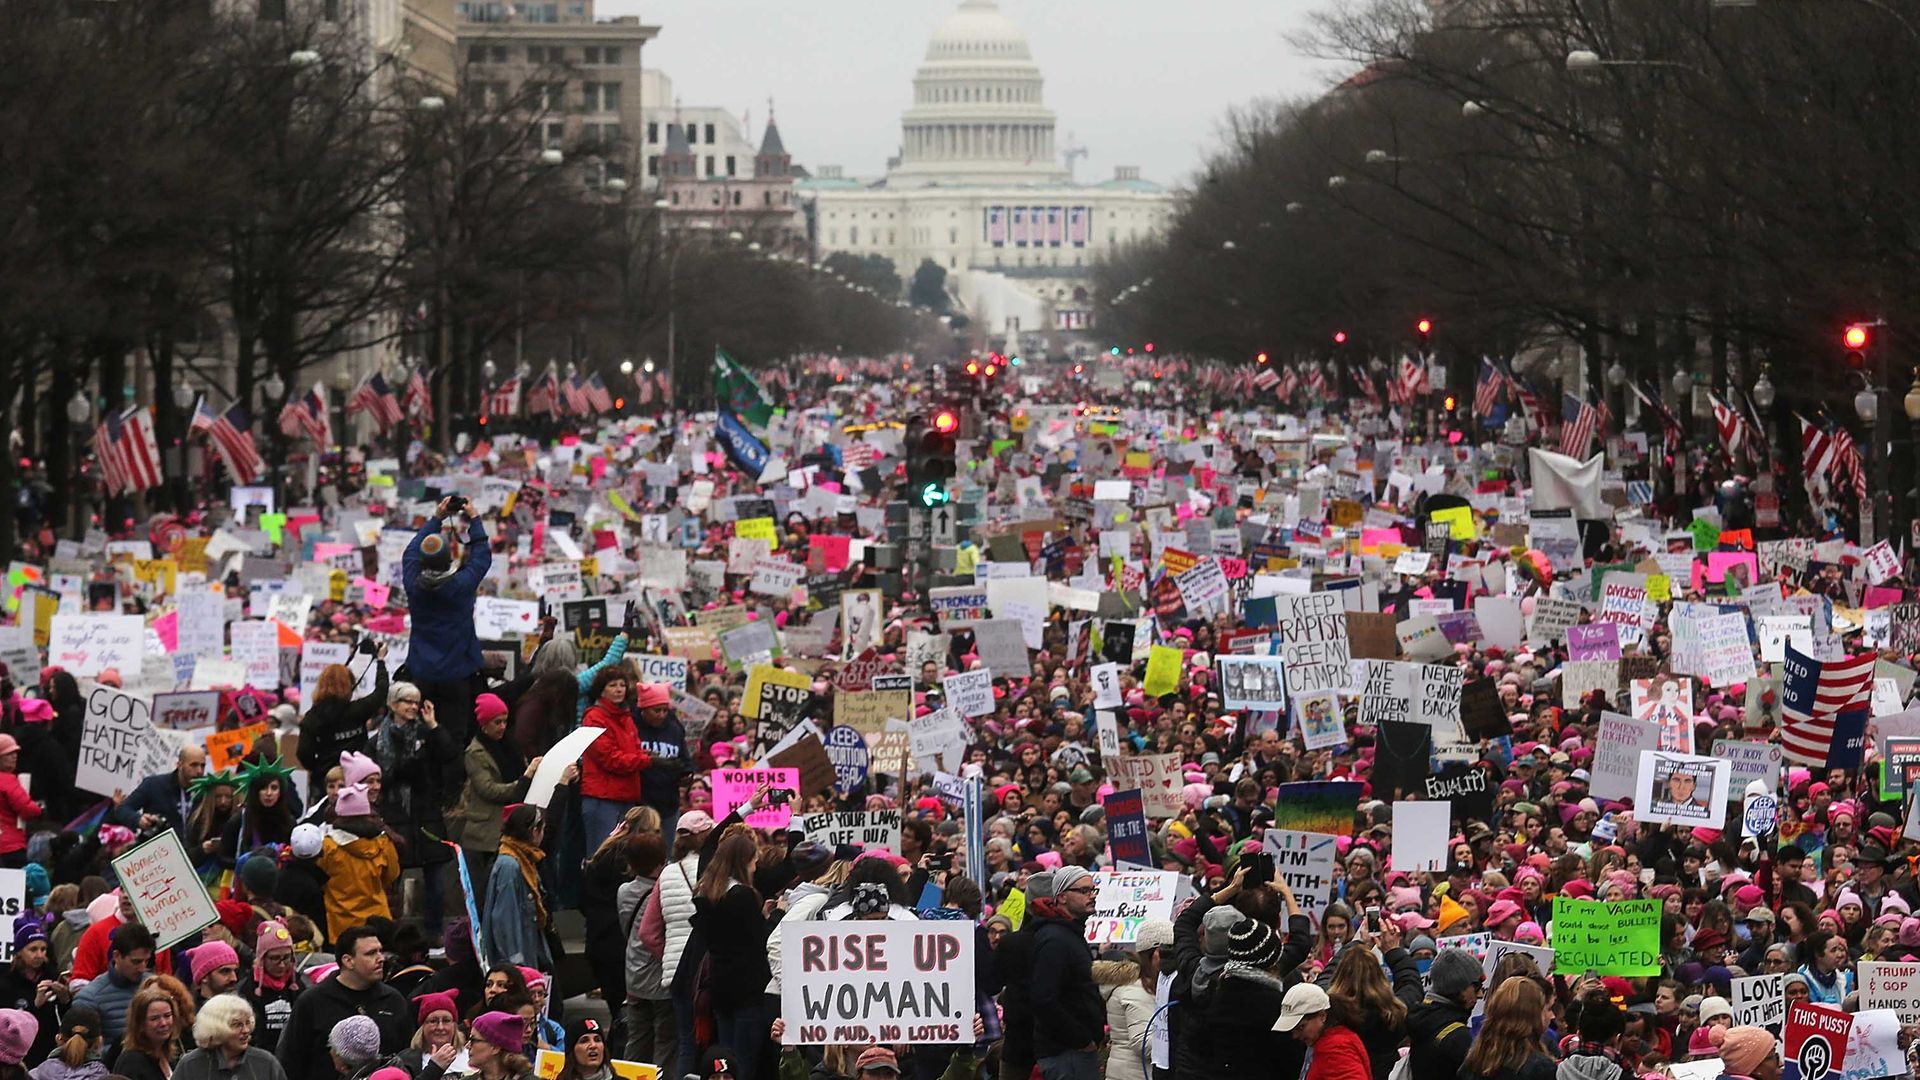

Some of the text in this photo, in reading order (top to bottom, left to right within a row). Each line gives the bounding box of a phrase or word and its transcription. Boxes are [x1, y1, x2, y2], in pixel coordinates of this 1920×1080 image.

[753, 570, 791, 587] POTU
[1606, 584, 1647, 600] DIVERSITY
[931, 594, 987, 609] STRONGER
[1290, 595, 1334, 617] KEEP
[1605, 597, 1642, 613] MAKES
[1601, 610, 1641, 626] AMERICA
[1280, 614, 1347, 643] RAPISTS
[1577, 626, 1604, 640] Yes
[1615, 626, 1636, 640] EAT
[1287, 640, 1348, 668] OFF MY
[641, 659, 685, 678] TCHES
[1368, 661, 1395, 680] WE
[1422, 665, 1463, 685] NEVER
[1785, 657, 1808, 678] ITED
[1289, 664, 1352, 691] CAMPUS
[761, 684, 809, 704] STOP
[1364, 680, 1392, 695] ARE
[90, 688, 149, 731] GOD
[1363, 696, 1409, 713] CITIZENS
[1422, 699, 1457, 721] BACK
[831, 727, 859, 746] KEEP
[1603, 719, 1644, 737] WOMEN'S
[884, 733, 907, 745] MY
[1602, 730, 1637, 746] RIGHTS
[825, 745, 866, 767] BORTION
[1727, 748, 1764, 760] MY BODY
[1892, 754, 1920, 764] STRO
[1104, 757, 1180, 777] UNITED WE
[1597, 763, 1632, 777] RIGHTS
[1731, 761, 1768, 774] DECISION
[723, 772, 786, 783] WOMENS
[834, 766, 863, 786] EGAL
[1127, 779, 1156, 788] STND
[1425, 767, 1486, 799] EQUALITY
[804, 810, 901, 833] KEEP YOUR LAWS
[829, 827, 888, 845] OFF OUR
[122, 846, 169, 877] Women's
[1280, 851, 1307, 866] I'M
[1283, 872, 1320, 889] ITH
[143, 888, 188, 917] Human
[1293, 893, 1315, 908] ER
[1606, 902, 1654, 916] VAGINA
[154, 906, 196, 931] Rights
[1115, 902, 1147, 918] Right
[1617, 916, 1658, 928] BULLETS
[1588, 934, 1600, 944] be
[802, 934, 961, 972] RISE UP
[1554, 950, 1653, 967] REGULATED
[1876, 967, 1916, 977] TRUMP
[1741, 976, 1783, 1003] LOVE
[1883, 981, 1908, 991] GOP
[802, 981, 962, 1020] WOMAN.
[1868, 999, 1907, 1009] HANDS
[1733, 999, 1783, 1027] NOT HATE
[1898, 1014, 1920, 1024] MEN
[1793, 1008, 1850, 1036] THIS PUSSY
[800, 1024, 960, 1043] NO MUD, NO LOTUS
